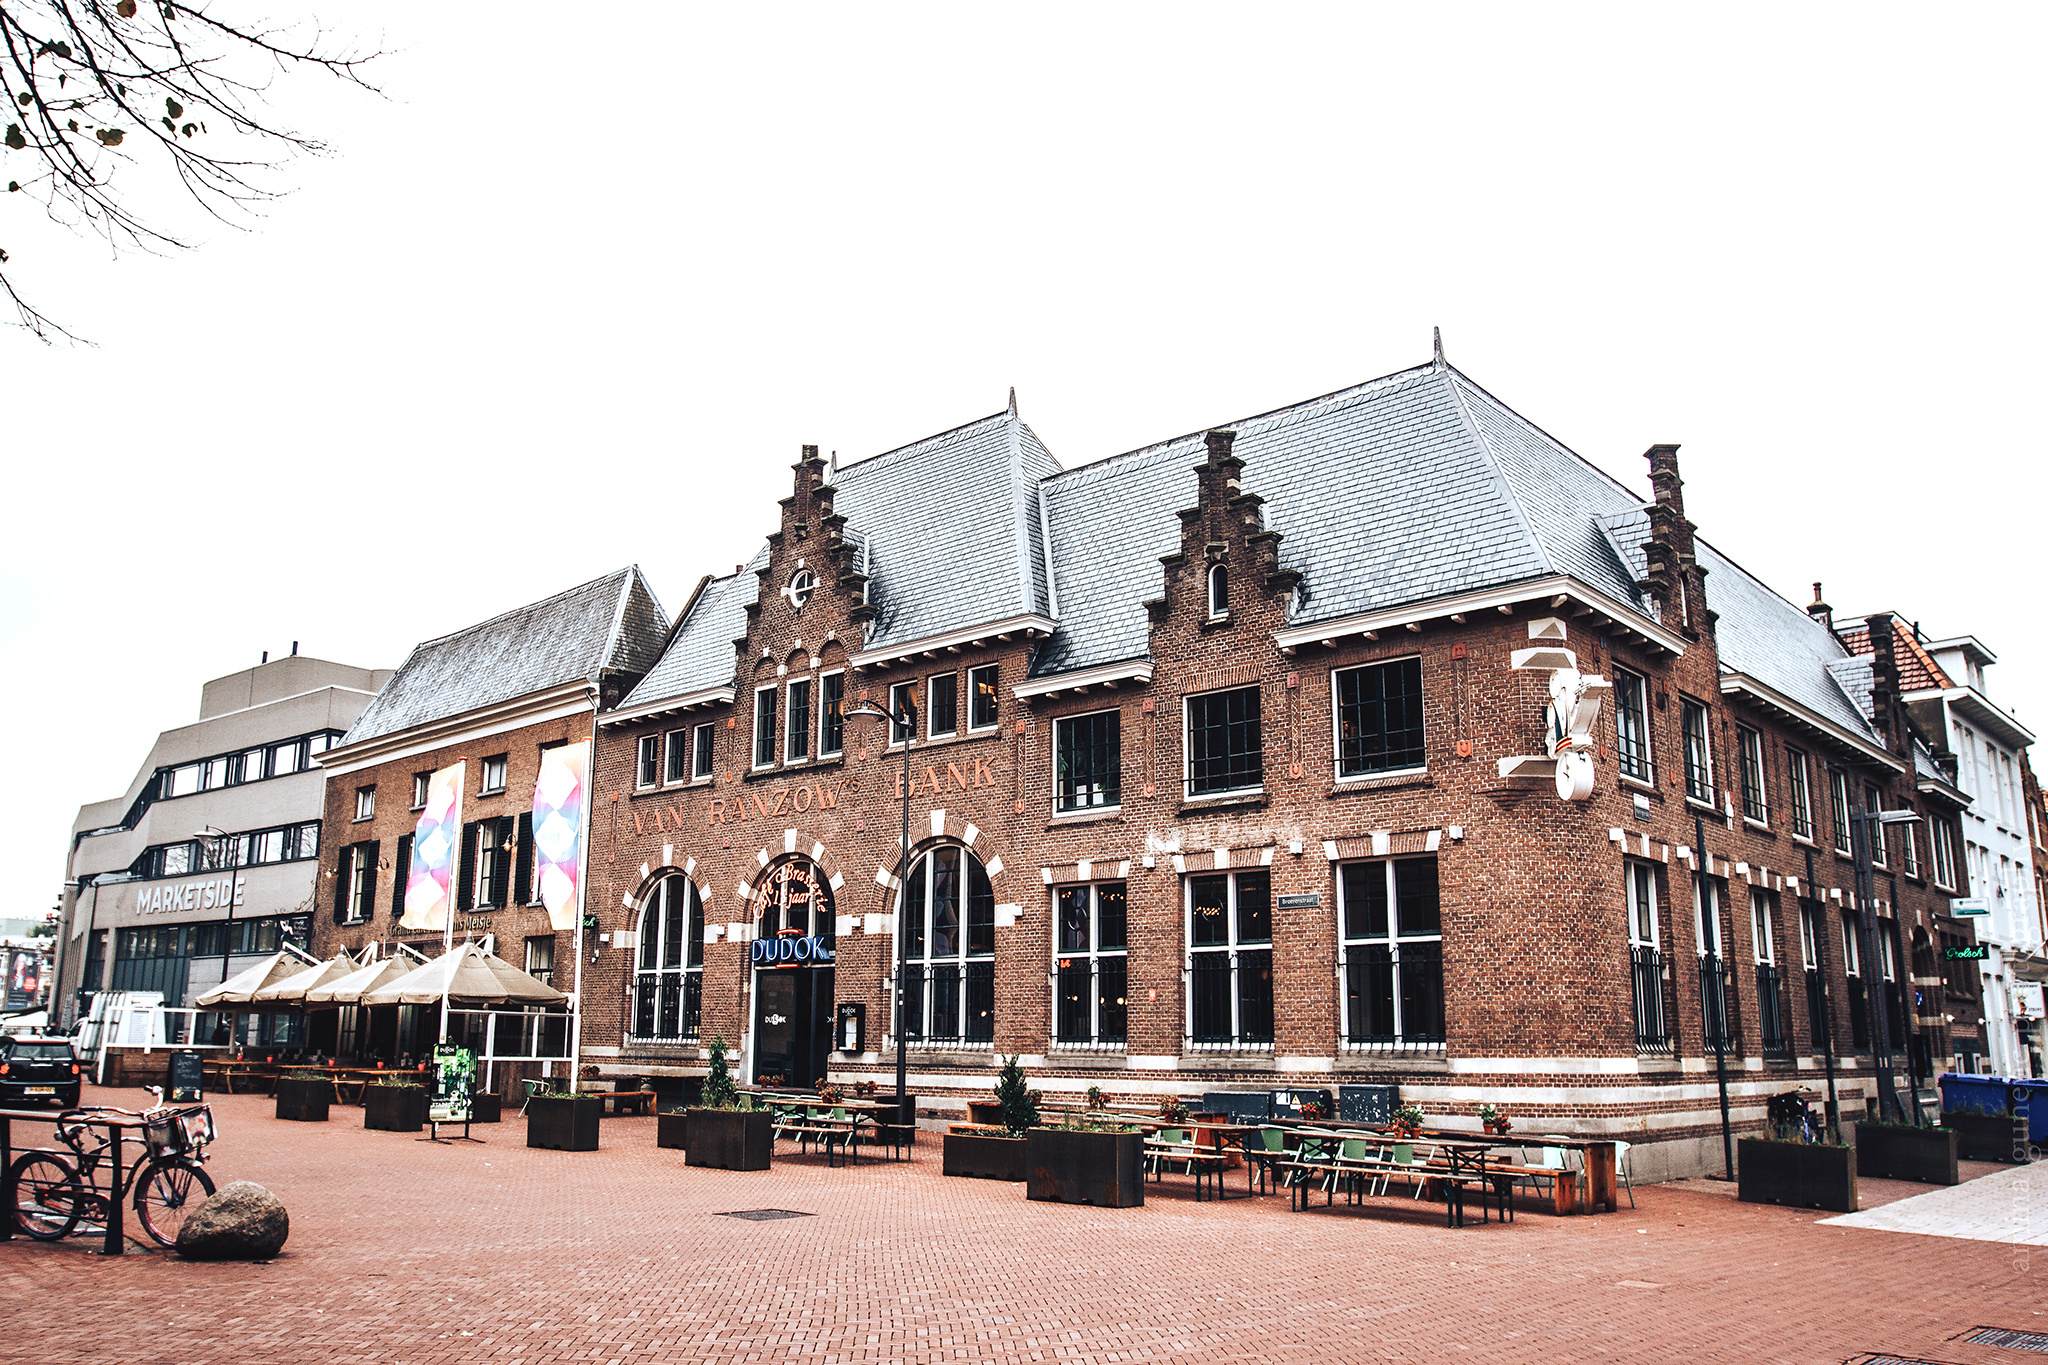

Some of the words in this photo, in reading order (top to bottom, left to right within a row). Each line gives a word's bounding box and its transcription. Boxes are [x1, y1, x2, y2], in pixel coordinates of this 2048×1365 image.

[633, 805, 683, 836] VAN
[894, 756, 996, 800] BANK
[136, 878, 246, 915] MARKETSIDE
[786, 863, 829, 913] Brasserie
[786, 887, 811, 910] jaar
[752, 936, 829, 962] DUDOK
[1946, 947, 1984, 960] Grolsch
